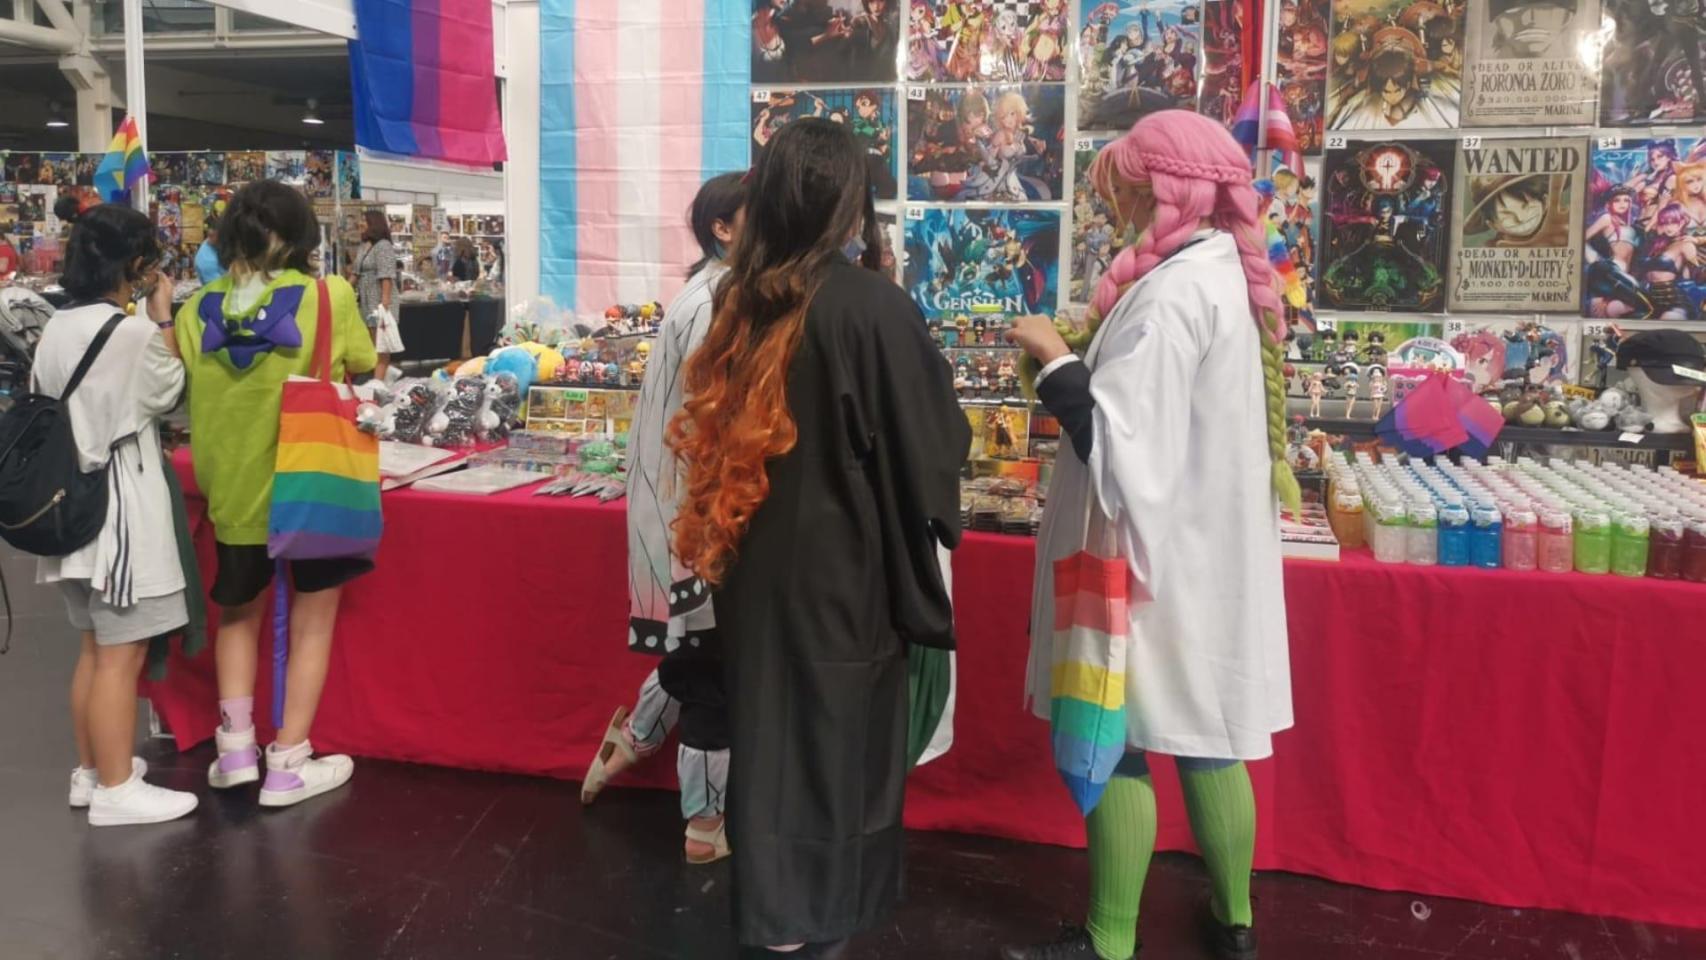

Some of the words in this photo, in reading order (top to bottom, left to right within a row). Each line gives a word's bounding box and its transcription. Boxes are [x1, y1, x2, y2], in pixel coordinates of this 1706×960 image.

[1478, 63, 1509, 72] DEAD
[1518, 62, 1533, 71] OR
[1481, 73, 1537, 92] RORONOA
[1540, 71, 1576, 91] ZORO
[757, 92, 768, 100] 47
[911, 89, 922, 97] 43
[1544, 103, 1583, 115] MARINE
[1078, 141, 1090, 150] 59
[1329, 137, 1343, 146] 22
[1465, 138, 1479, 147] 37
[1463, 147, 1580, 174] WANTED
[1464, 249, 1496, 259] DEAD
[1504, 249, 1519, 258] OR
[1528, 248, 1568, 258] ALIVE
[1531, 292, 1571, 302] MARINE
[1448, 322, 1462, 331] 38
[1589, 326, 1600, 335] 35
